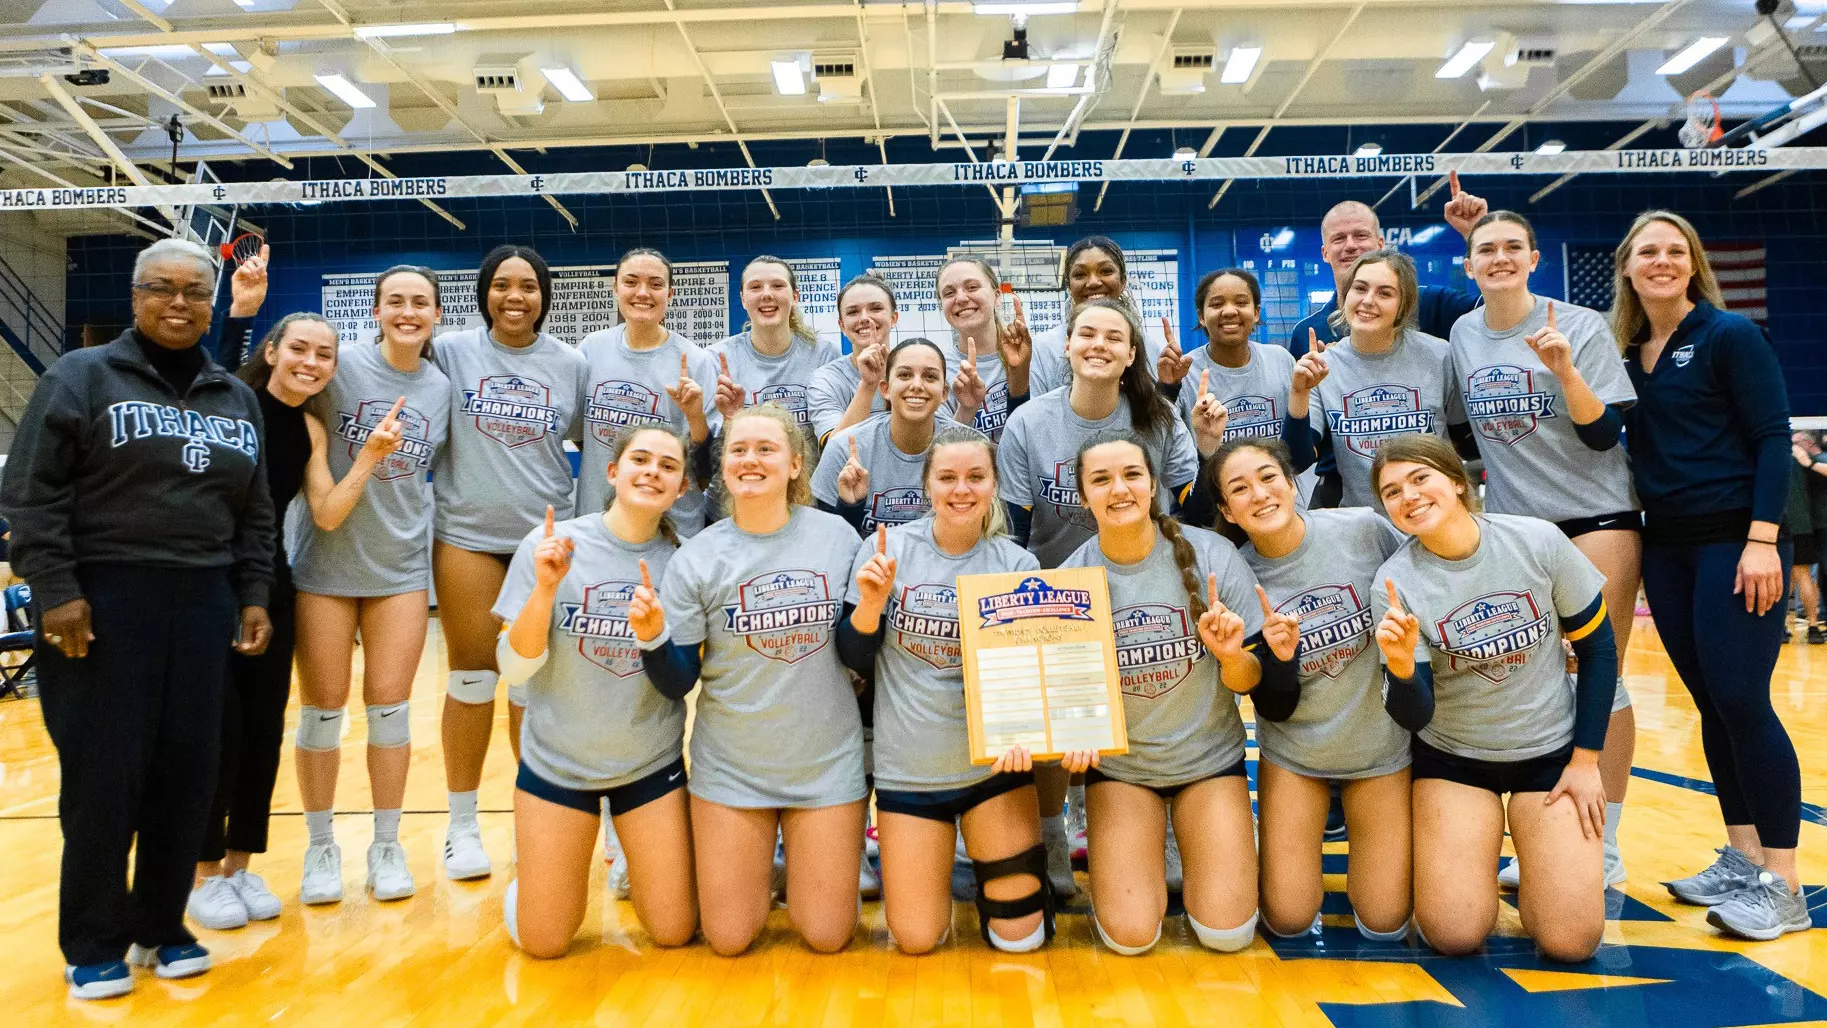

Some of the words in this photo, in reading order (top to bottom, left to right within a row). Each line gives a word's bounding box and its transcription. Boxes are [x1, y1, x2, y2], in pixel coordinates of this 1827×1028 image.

[1286, 157, 1349, 174] ITHACA
[1356, 156, 1434, 173] BOMBERS
[1618, 152, 1681, 168] ITHACA
[1688, 150, 1767, 167] BOMBERS
[625, 171, 688, 189] ITHACA
[694, 169, 772, 187] BOMBERS
[954, 164, 1018, 181] ITHACA
[1024, 161, 1102, 179] BOMBERS
[0, 190, 46, 206] HACA
[52, 188, 127, 206] BOMBERS
[302, 181, 364, 199] ITHACA
[370, 179, 446, 197] BOMBERS
[558, 270, 600, 278] VOLLEYBALL
[684, 266, 728, 274] BASKETBALL
[554, 281, 595, 290] EMPIRE
[597, 281, 604, 289] 8
[708, 277, 715, 285] 8
[551, 300, 614, 311] HAMPIONS
[693, 309, 724, 318] 2000-01
[549, 314, 577, 323] 1999
[582, 313, 610, 322] 2004
[693, 321, 724, 330] 2003-04
[549, 325, 577, 334] 2005
[1355, 394, 1381, 405] LIBERTY
[1382, 393, 1407, 402] LEAGUE
[1469, 397, 1541, 415] CHAMPIONS
[472, 400, 554, 422] CHAMPIONS
[108, 400, 259, 463] ITHACA
[486, 422, 537, 437] VOLLEYBALL
[1342, 414, 1427, 433] CHAMPIONS
[347, 425, 429, 457] CHONS
[885, 497, 911, 506] LIBERTY
[786, 578, 815, 589] LEAGUE
[915, 591, 947, 603] LIBERTY
[980, 591, 1035, 612] LIBERTY
[1038, 590, 1090, 604] LEAGUE
[1312, 594, 1342, 609] LEAGUE
[737, 604, 835, 632] CHAMPIONS
[1142, 614, 1171, 626] LEAGUE
[1454, 610, 1486, 631] LIBERTY
[1486, 601, 1519, 617] LEAGUE
[760, 632, 820, 649] VOLLEYBALL
[1118, 638, 1197, 666] AMPIONS
[1302, 645, 1360, 672] VOLLEYBALL
